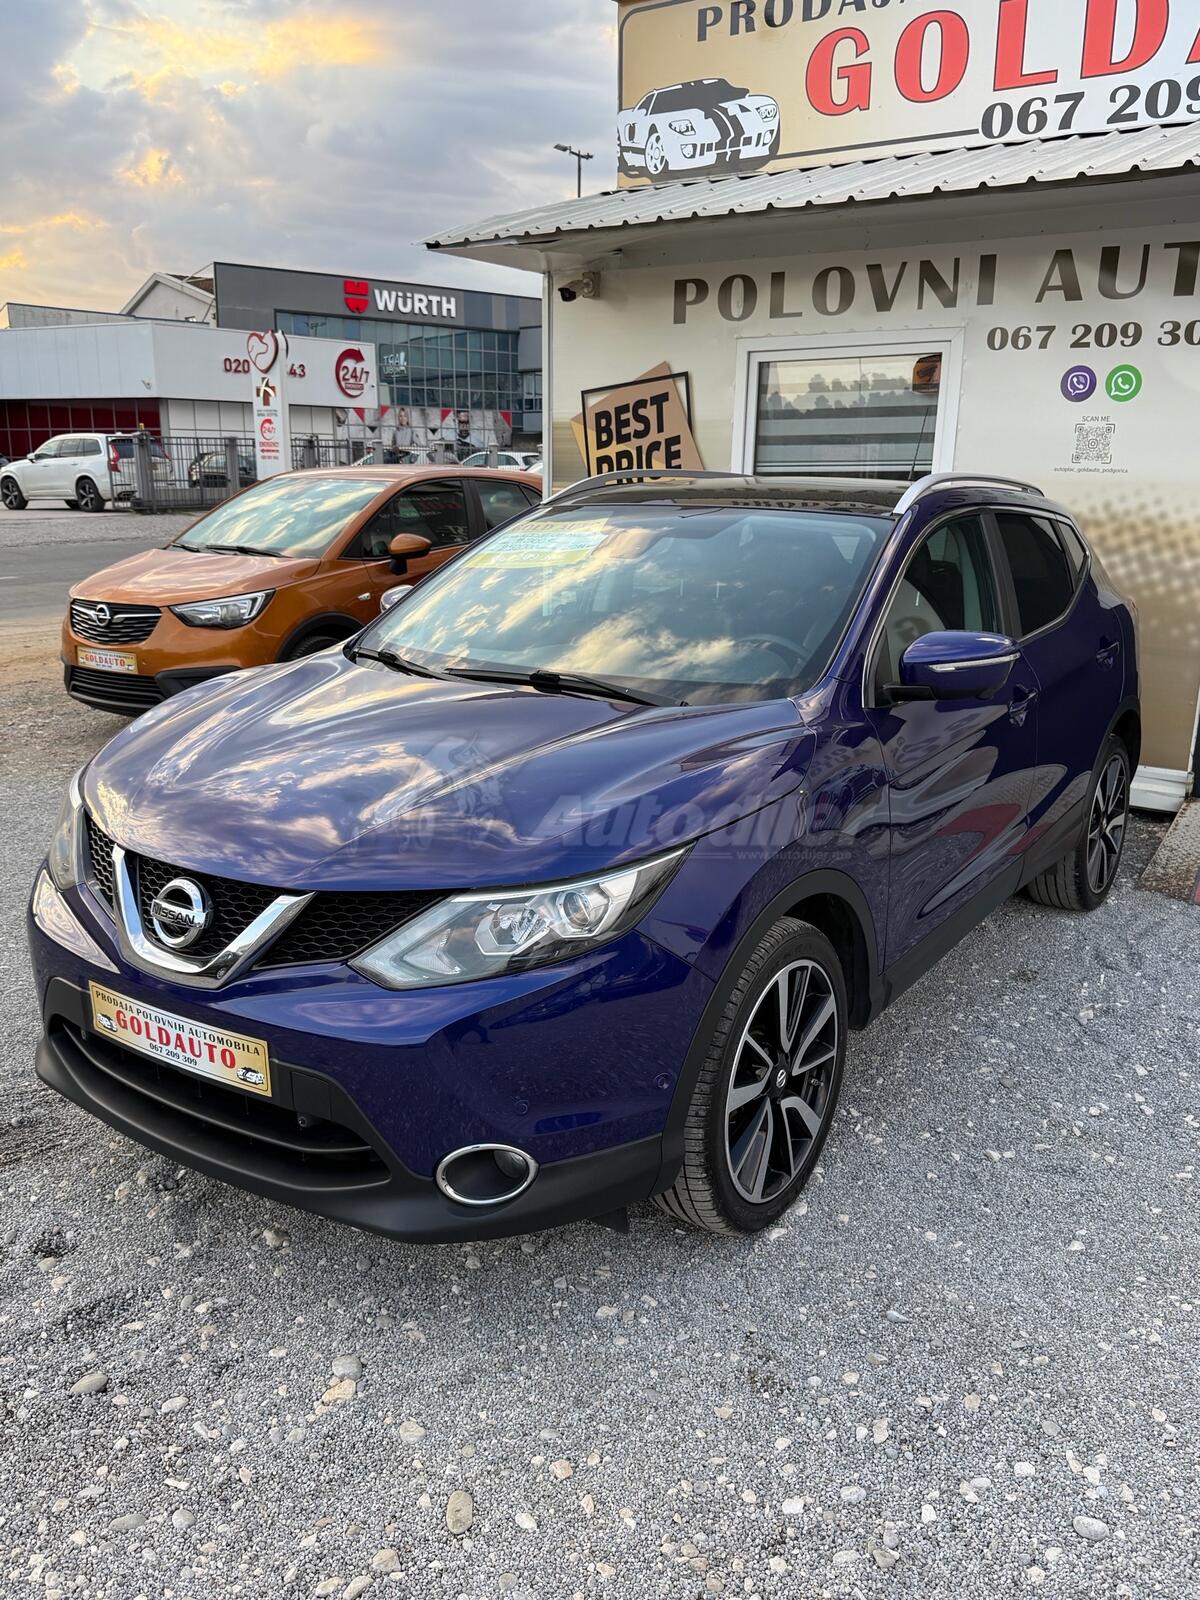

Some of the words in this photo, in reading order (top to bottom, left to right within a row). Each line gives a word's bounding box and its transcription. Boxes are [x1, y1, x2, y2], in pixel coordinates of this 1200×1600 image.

[697, 0, 908, 42] PROD
[980, 91, 1086, 140] 067
[673, 254, 998, 325] POLOVNI
[1035, 241, 1200, 304] AUT
[373, 288, 457, 319] WÜRTH
[986, 325, 1057, 351] 067
[1069, 321, 1143, 350] 209
[1157, 319, 1200, 347] 30
[223, 357, 250, 374] 020
[341, 365, 370, 383] 24/7
[594, 391, 670, 451] BEST
[1081, 415, 1100, 423] SCAN
[1101, 415, 1112, 423] ME
[85, 653, 126, 668] GOLDAUTO
[151, 900, 196, 925] NISSAN
[95, 990, 134, 1014] PRODAJA
[136, 1008, 185, 1033] POLOVNIH
[188, 1027, 261, 1056] AUTOMOBILA
[115, 1009, 236, 1069] GOLDAUTO
[149, 1042, 163, 1053] 067
[165, 1048, 180, 1060] 209
[181, 1054, 198, 1067] 309
